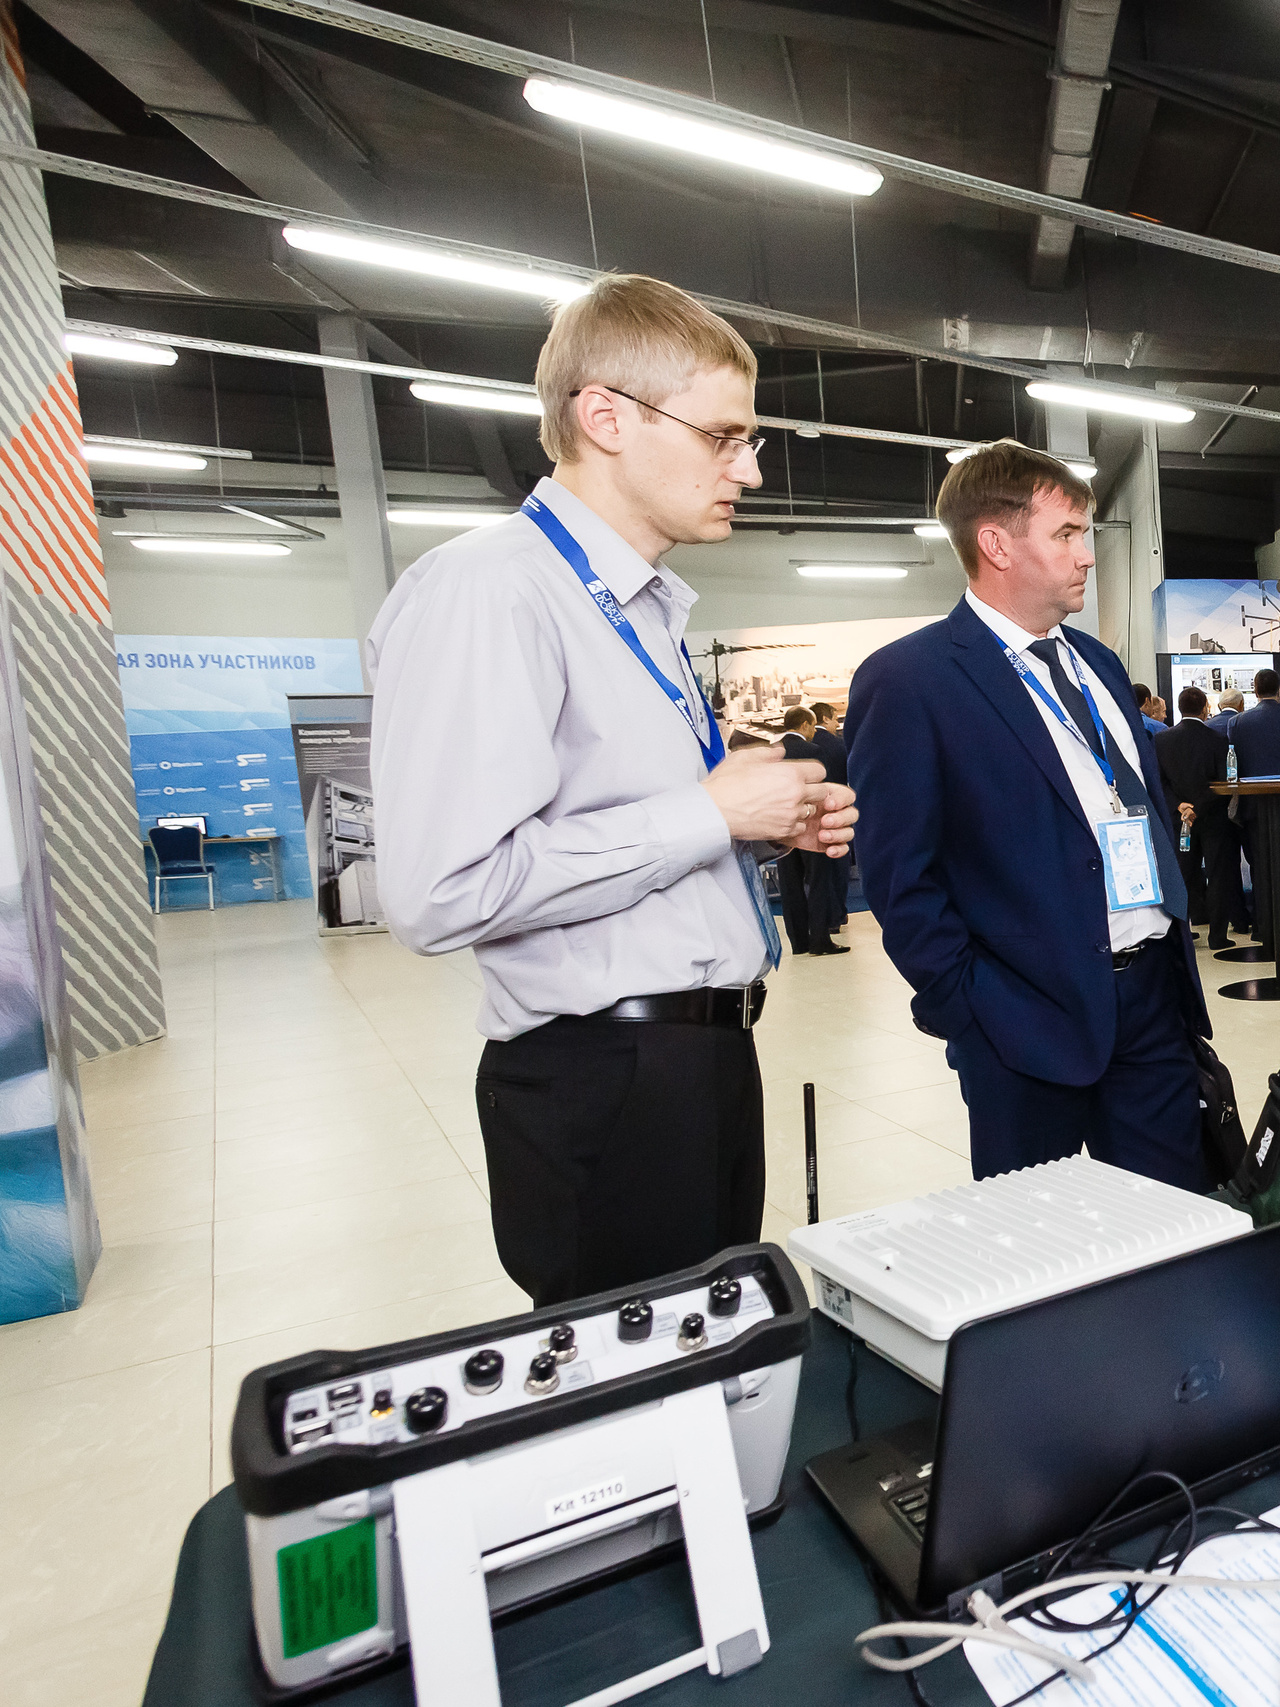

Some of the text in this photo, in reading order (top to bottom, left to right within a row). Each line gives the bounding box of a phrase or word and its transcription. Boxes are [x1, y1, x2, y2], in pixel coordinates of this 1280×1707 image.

[595, 594, 621, 626] ФОРУМ
[603, 592, 625, 622] СПЕКТР
[145, 653, 194, 669] ЗОНА
[198, 654, 316, 670] УЧАСТНИКОВ
[554, 1483, 623, 1514] Kit 12110
